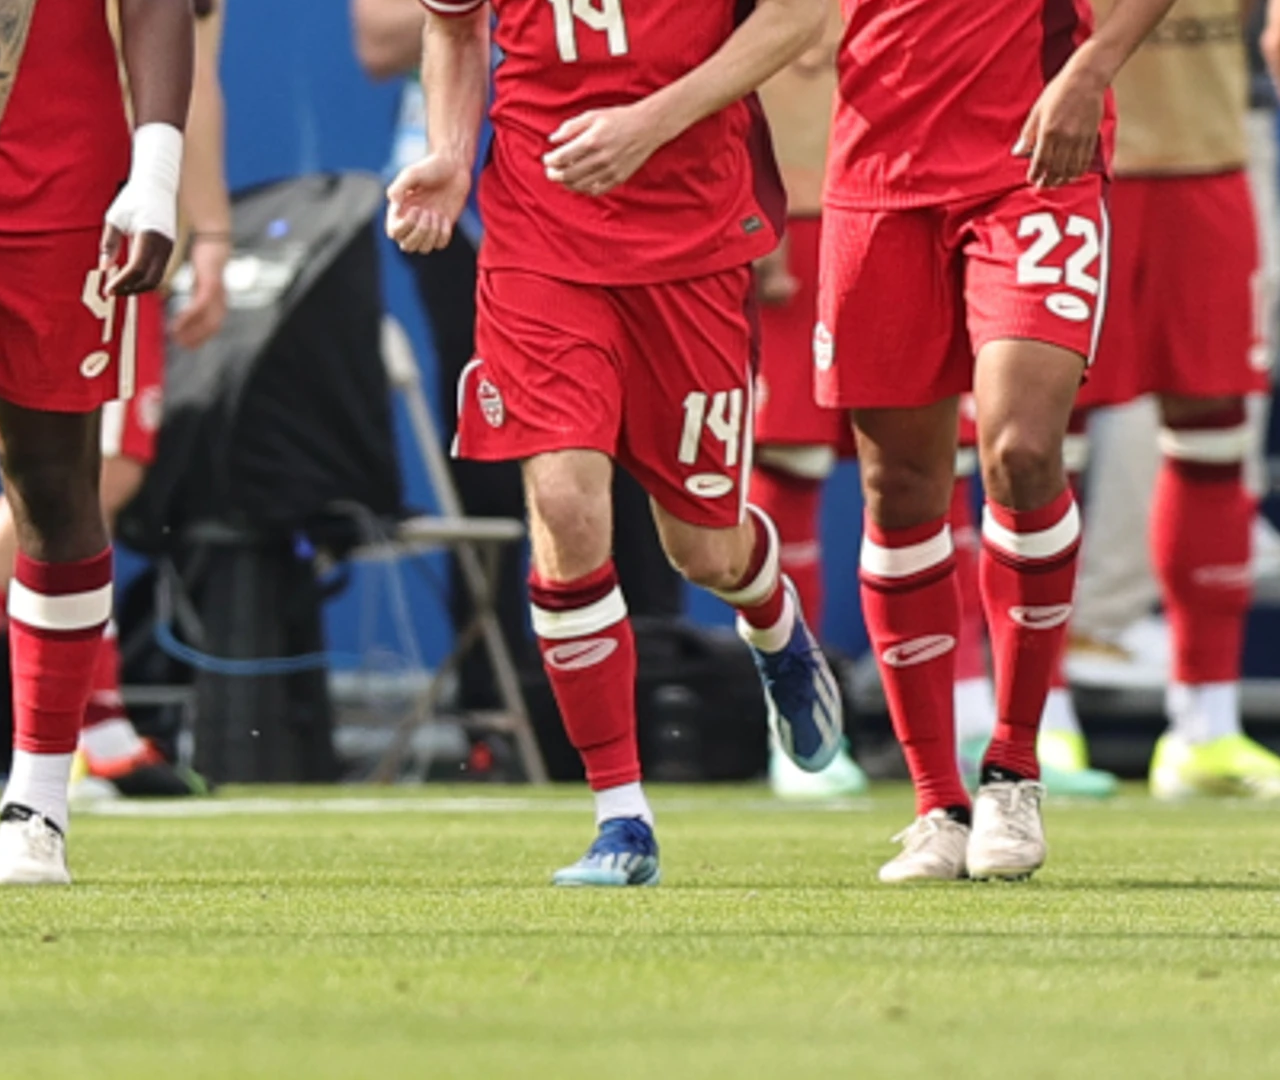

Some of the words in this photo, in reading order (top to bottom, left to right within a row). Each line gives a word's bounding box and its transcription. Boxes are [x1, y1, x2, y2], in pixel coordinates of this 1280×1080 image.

[1016, 212, 1100, 297] 22
[81, 266, 119, 344] 4
[678, 388, 742, 467] 14
